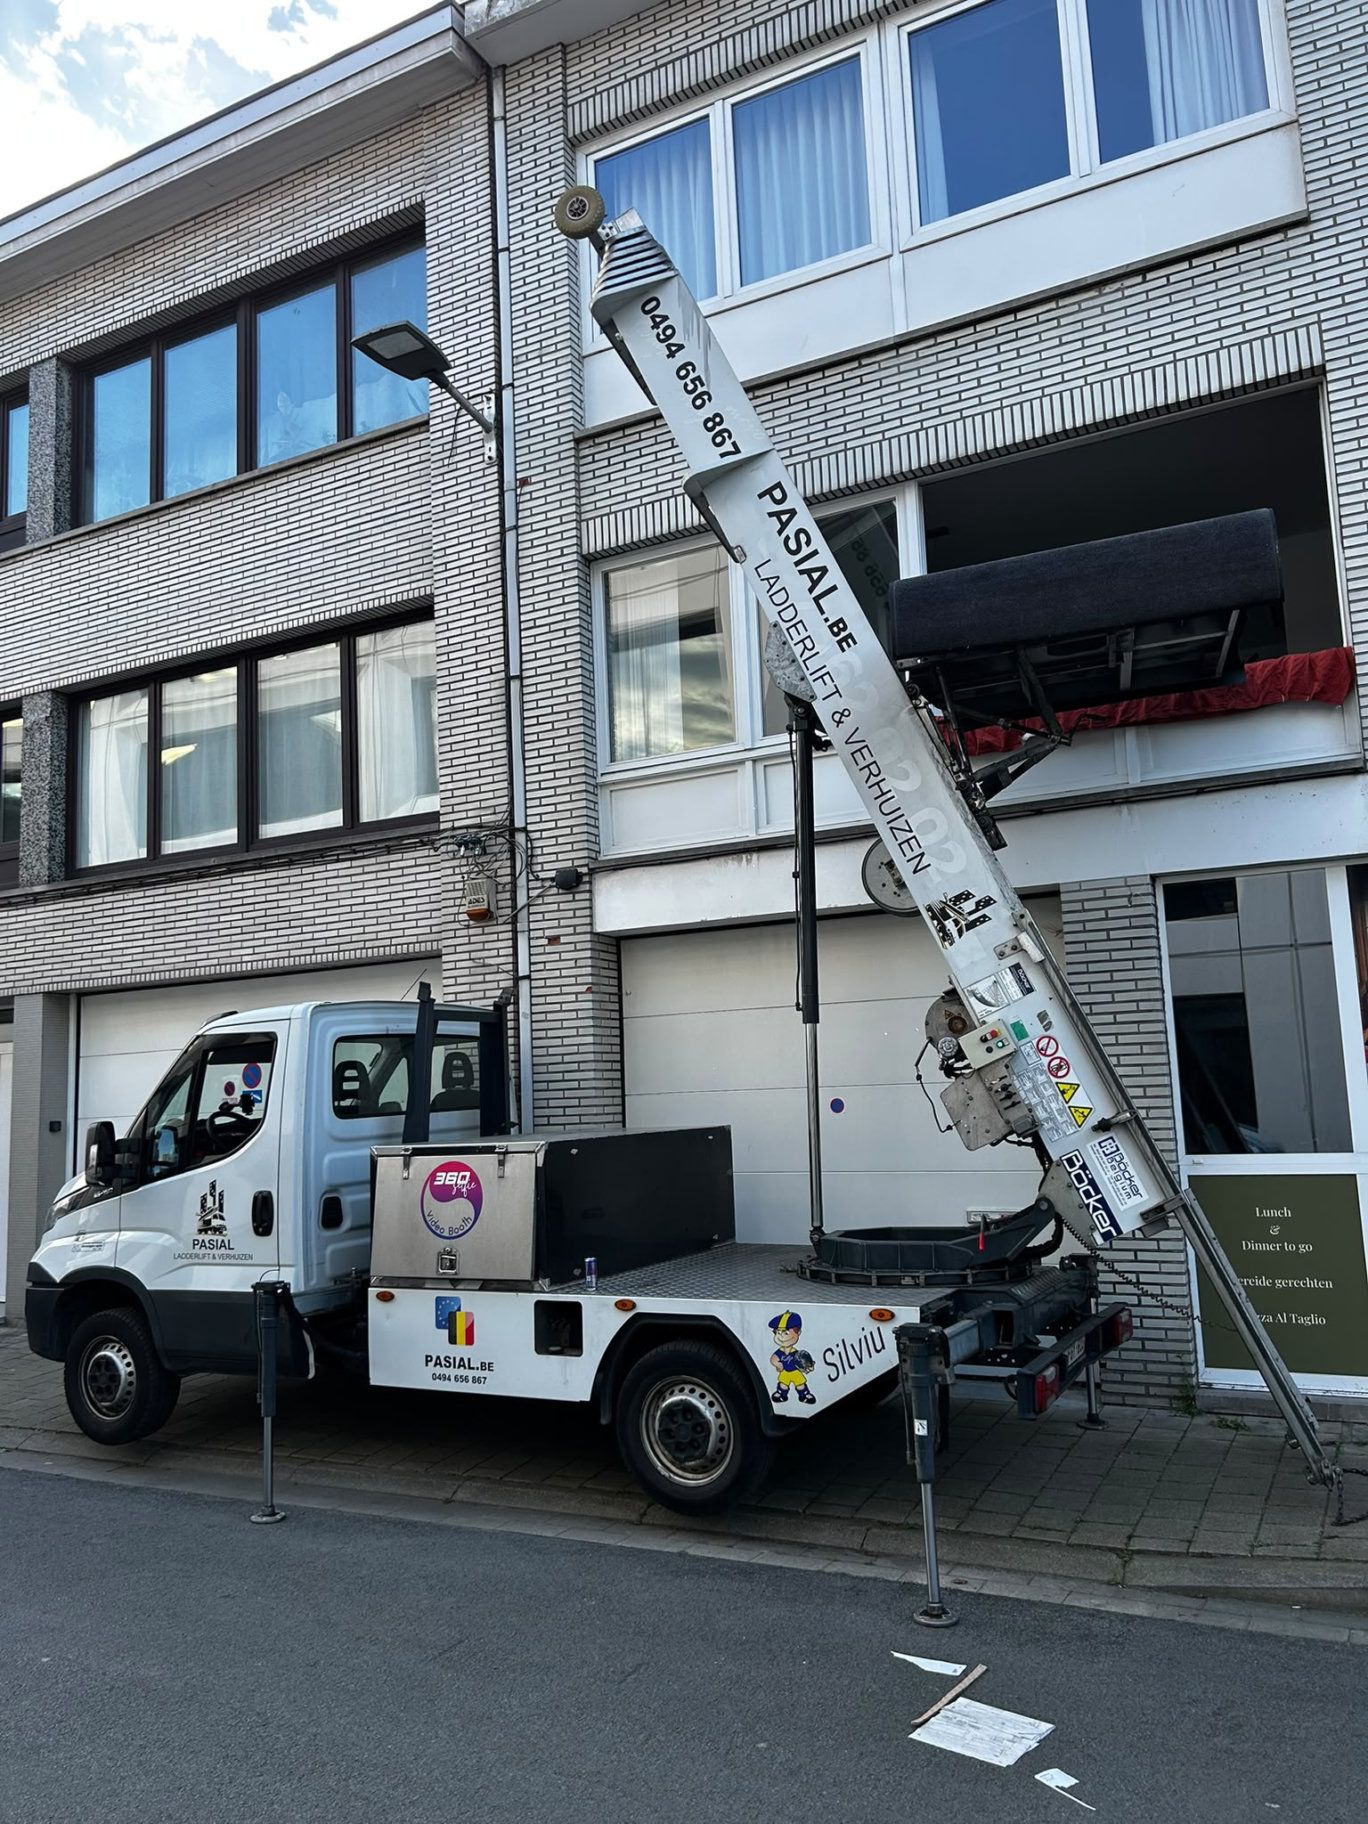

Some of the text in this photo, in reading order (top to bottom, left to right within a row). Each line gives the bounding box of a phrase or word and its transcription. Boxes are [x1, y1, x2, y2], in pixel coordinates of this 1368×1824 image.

[640, 296, 741, 459] 0494 656 867
[757, 481, 857, 653] PASIAL.BE
[754, 558, 931, 875] LADDERLIFT & VERHUIZEN
[433, 1171, 471, 1186] 360
[1106, 1157, 1132, 1200] Belgium
[1114, 1152, 1143, 1198] Böcker
[1061, 1151, 1118, 1238] Böcker
[1255, 1206, 1292, 1218] Lunch
[426, 1209, 473, 1236] Video Booth
[1269, 1224, 1281, 1235] &
[192, 1238, 235, 1250] PASIAL
[1241, 1240, 1313, 1254] Dinner to go
[173, 1252, 211, 1260] LADDERLIFT
[217, 1253, 254, 1261] VERHUIZEN
[1238, 1275, 1334, 1289] ereide gerechten
[1275, 1312, 1288, 1323] Al
[1289, 1313, 1327, 1327] Taglio
[822, 1326, 886, 1383] Silviu
[424, 1354, 494, 1372] PASIAL.BE
[431, 1372, 488, 1385] 0494 656 867
